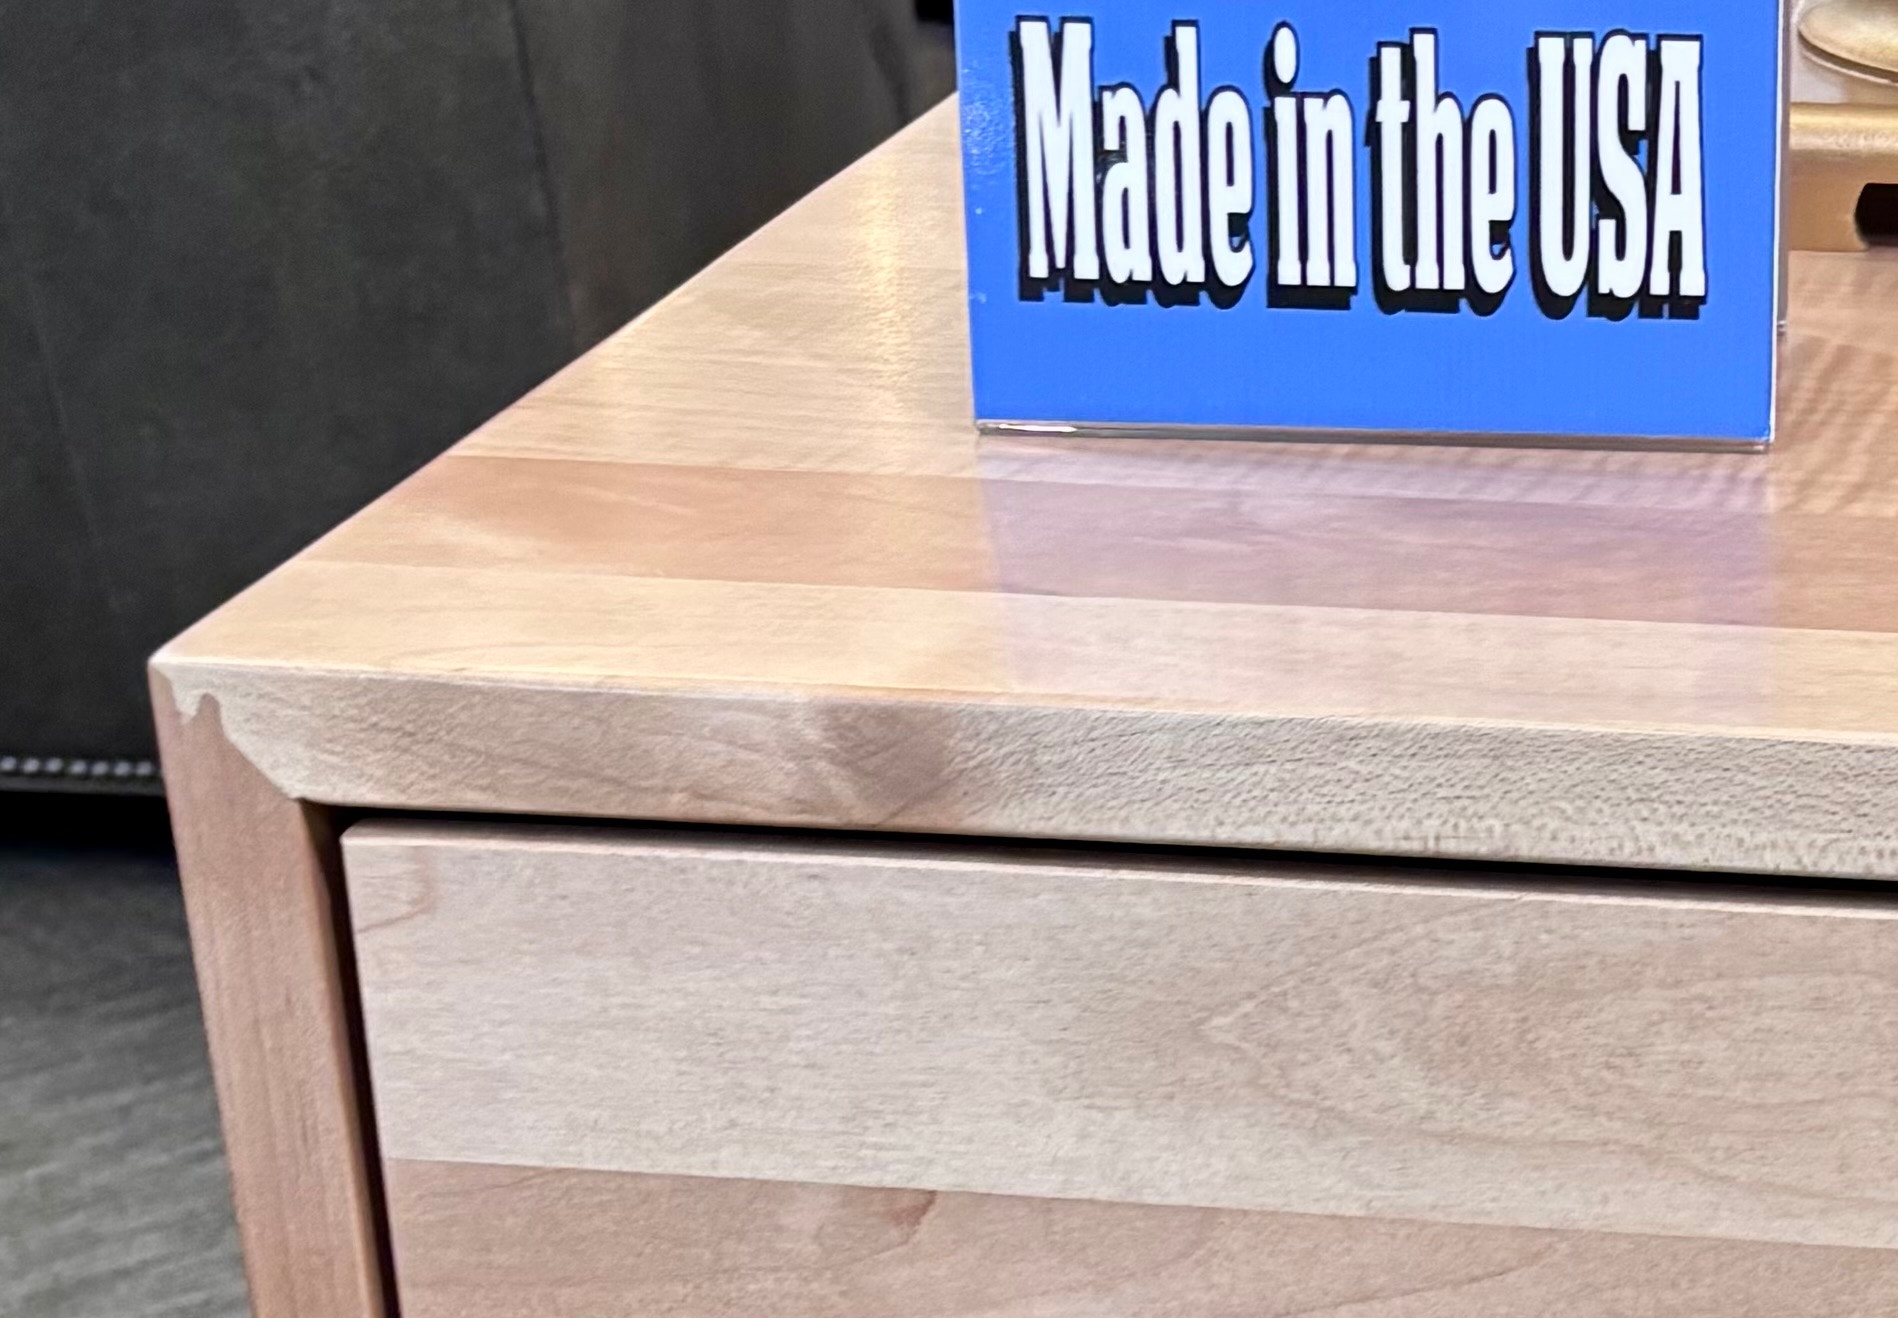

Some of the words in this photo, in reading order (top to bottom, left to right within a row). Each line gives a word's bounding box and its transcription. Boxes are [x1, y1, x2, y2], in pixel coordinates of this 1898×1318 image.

[1011, 16, 1255, 310] Made
[1264, 22, 1357, 310] in
[1366, 28, 1516, 315] the
[1529, 29, 1706, 321] USA
